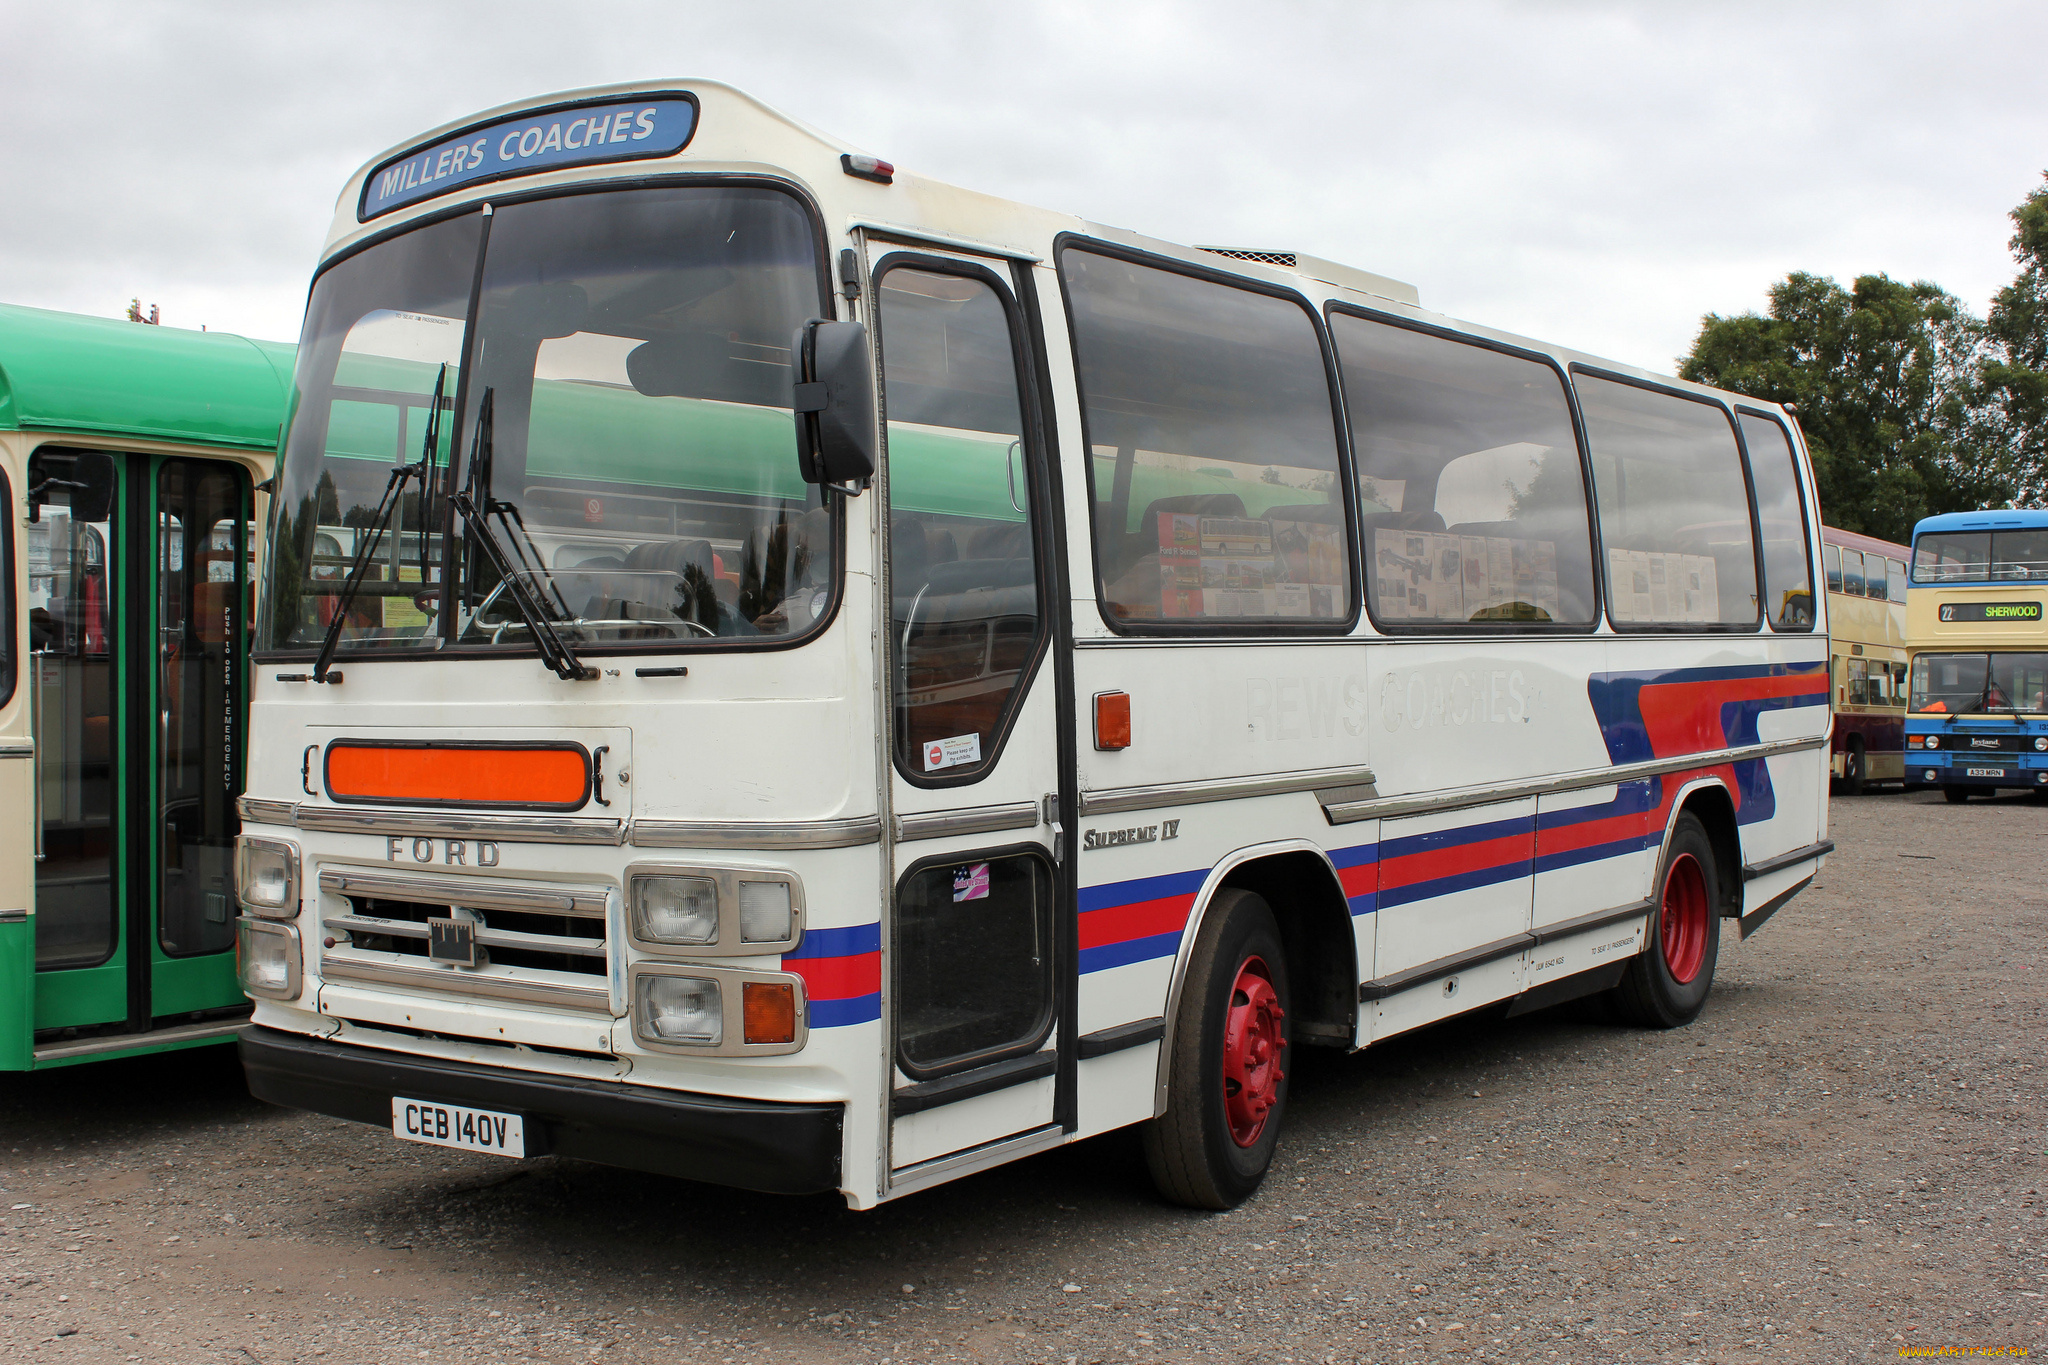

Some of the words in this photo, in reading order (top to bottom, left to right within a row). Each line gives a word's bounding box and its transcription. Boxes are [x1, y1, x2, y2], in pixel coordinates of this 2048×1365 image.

[379, 138, 487, 200] MILLERS
[499, 108, 657, 161] COACHES
[1160, 546, 1173, 555] Ford
[1180, 547, 1198, 556] Series
[1942, 606, 1952, 621] 22
[1985, 606, 2038, 617] SHERWOOD
[224, 641, 231, 654] to
[224, 690, 231, 704] in
[1382, 670, 1525, 732] COACHES
[224, 706, 232, 790] EMERGENCY
[1970, 768, 1984, 776] A33
[1083, 825, 1157, 850] SUPREME
[1161, 819, 1180, 840] IV
[386, 836, 500, 867] FORD
[1597, 944, 1606, 953] SEAT
[1611, 936, 1634, 949] PASSENGERS
[406, 1104, 449, 1139] CEB
[455, 1111, 507, 1148] 140V
